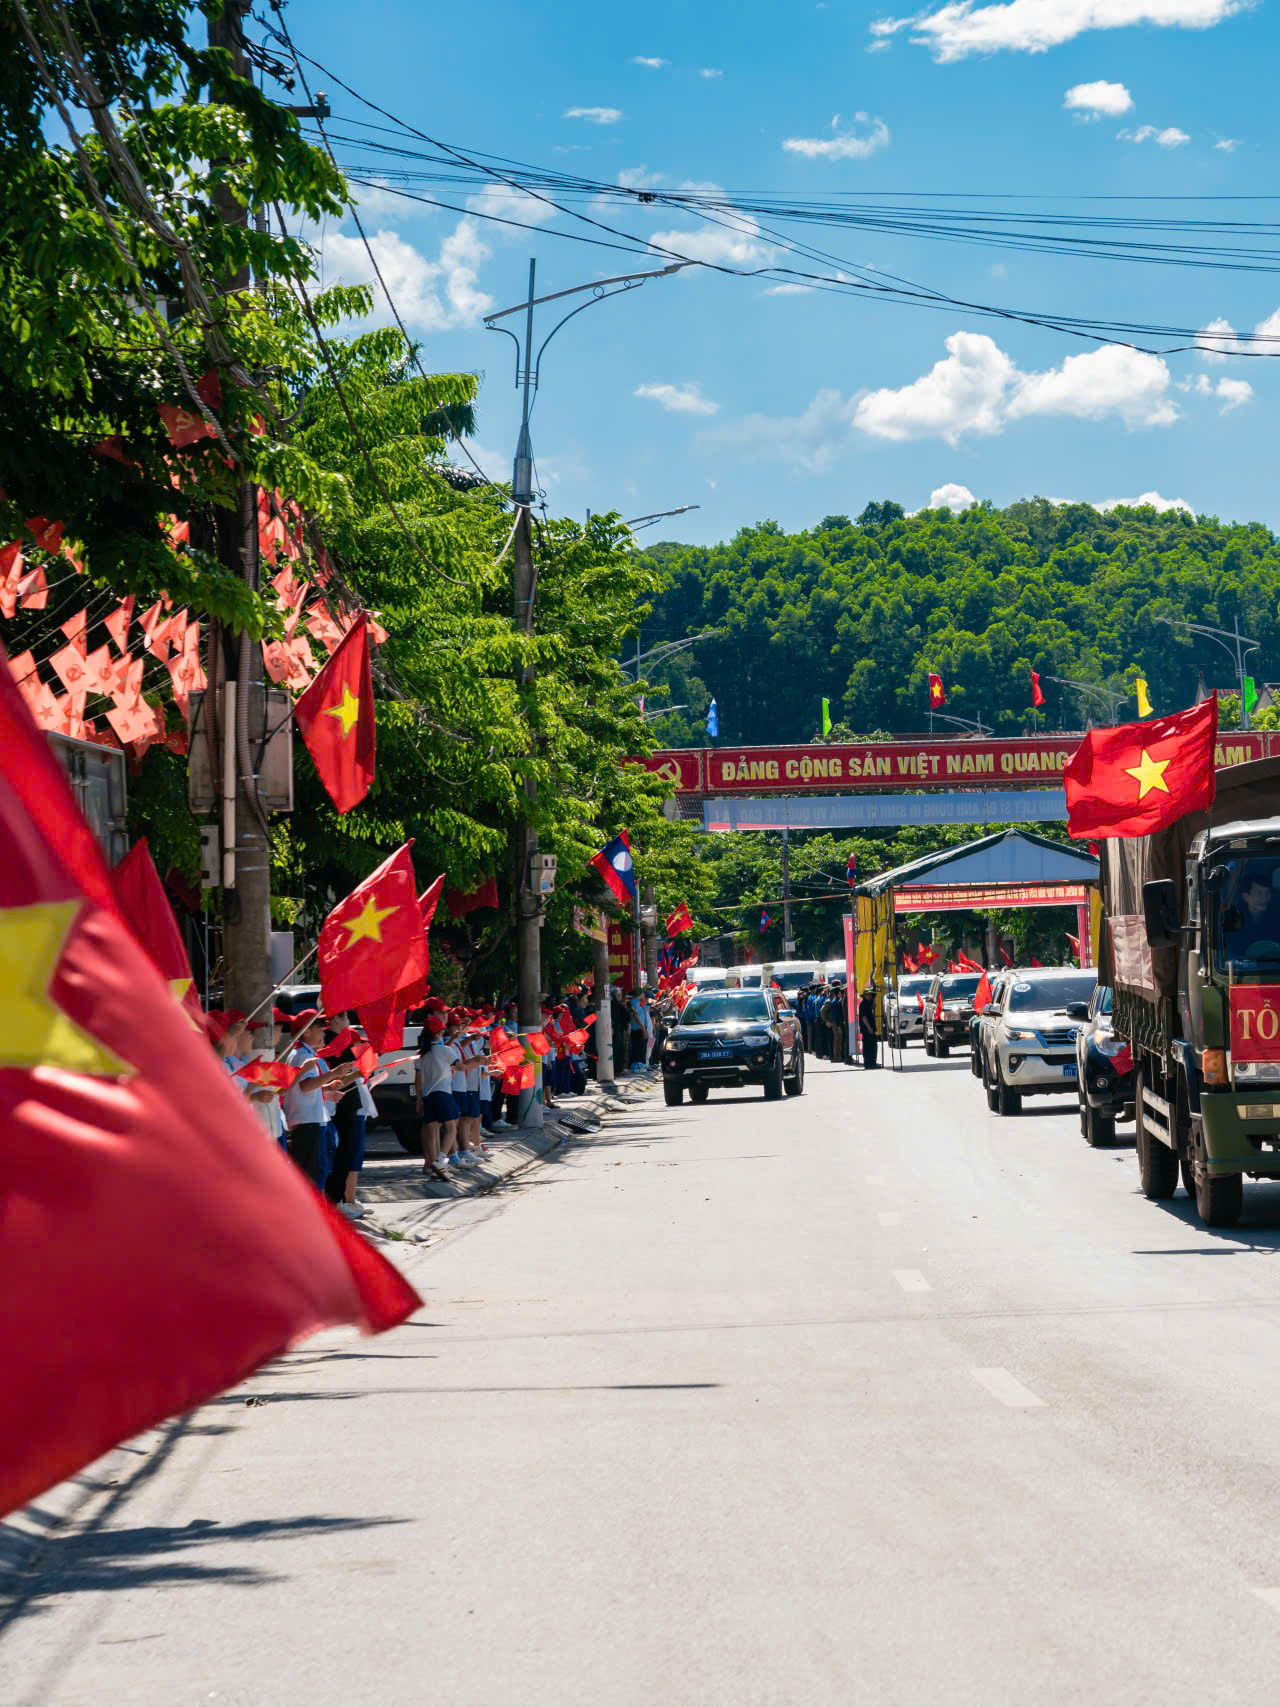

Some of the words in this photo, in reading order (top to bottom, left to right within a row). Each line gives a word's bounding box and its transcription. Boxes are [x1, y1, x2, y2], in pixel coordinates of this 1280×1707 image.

[722, 755, 779, 781] ĐẢNG
[786, 756, 842, 782] CỘNG
[849, 752, 891, 777] SẢN
[897, 752, 940, 779] VIỆT
[947, 754, 994, 774] NAM
[1001, 751, 1068, 774] QUANG
[1215, 743, 1251, 766] ĂM!
